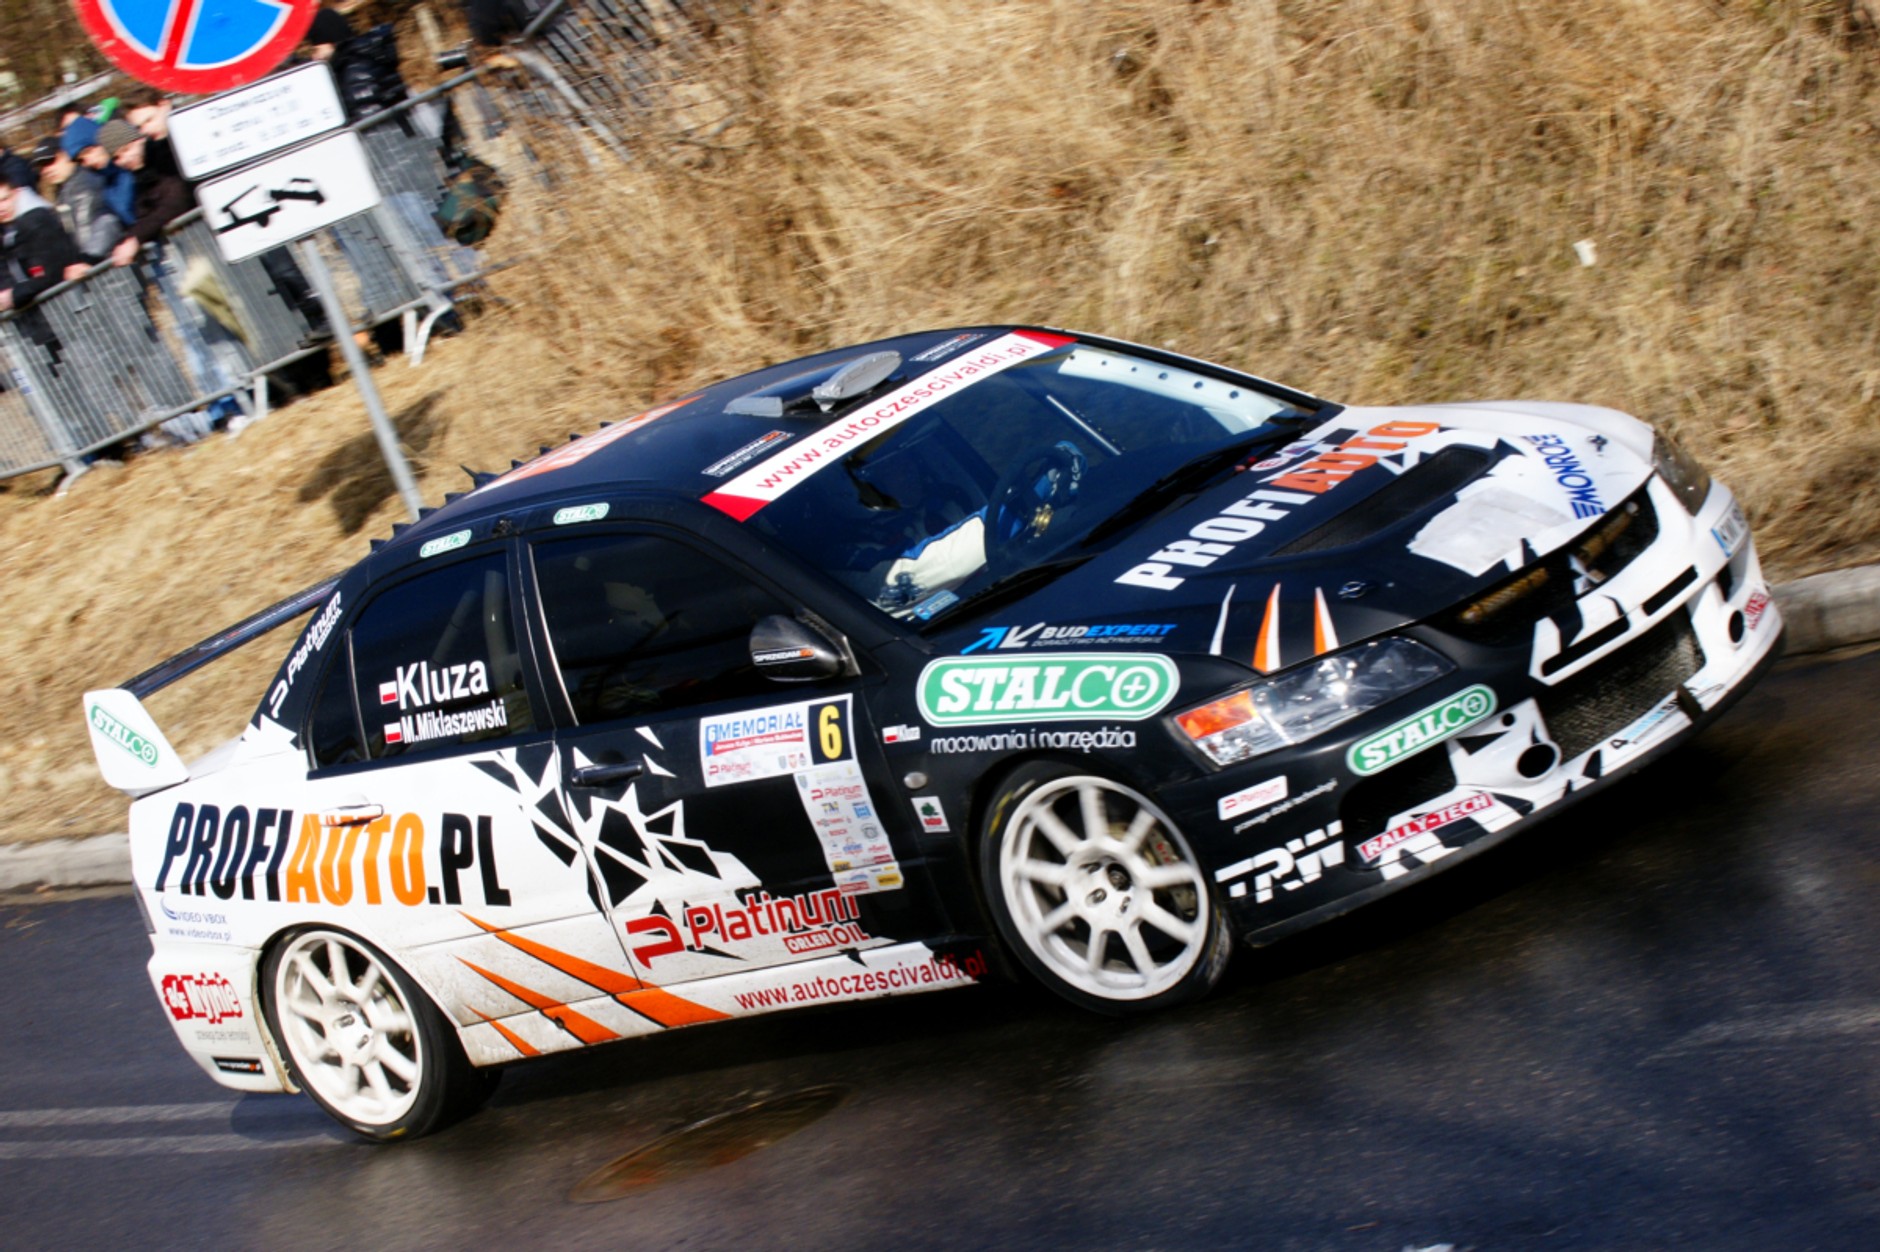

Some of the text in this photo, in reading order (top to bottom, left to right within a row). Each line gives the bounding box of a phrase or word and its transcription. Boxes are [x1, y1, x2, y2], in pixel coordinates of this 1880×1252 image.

[757, 342, 1034, 489] www.autoczescivaldi.pl
[1114, 421, 1441, 591] PROFIAUTO
[1040, 624, 1178, 640] BUDEXPERT
[397, 660, 489, 710] Kluza
[937, 665, 1160, 713] STALCO
[718, 713, 803, 739] MEMORIAŁ
[819, 705, 842, 759] 6
[931, 726, 1136, 754] mocowania i narzędzia
[1360, 692, 1488, 769] STALCO
[156, 802, 511, 907] PROFIAUTO.PL
[1366, 794, 1490, 857] RALLY-TECH
[1215, 820, 1344, 903] TRW
[686, 887, 861, 951] Platinum
[786, 923, 870, 953] ORLEN OIL
[734, 950, 988, 1010] www.autoczescivaldi.pl
